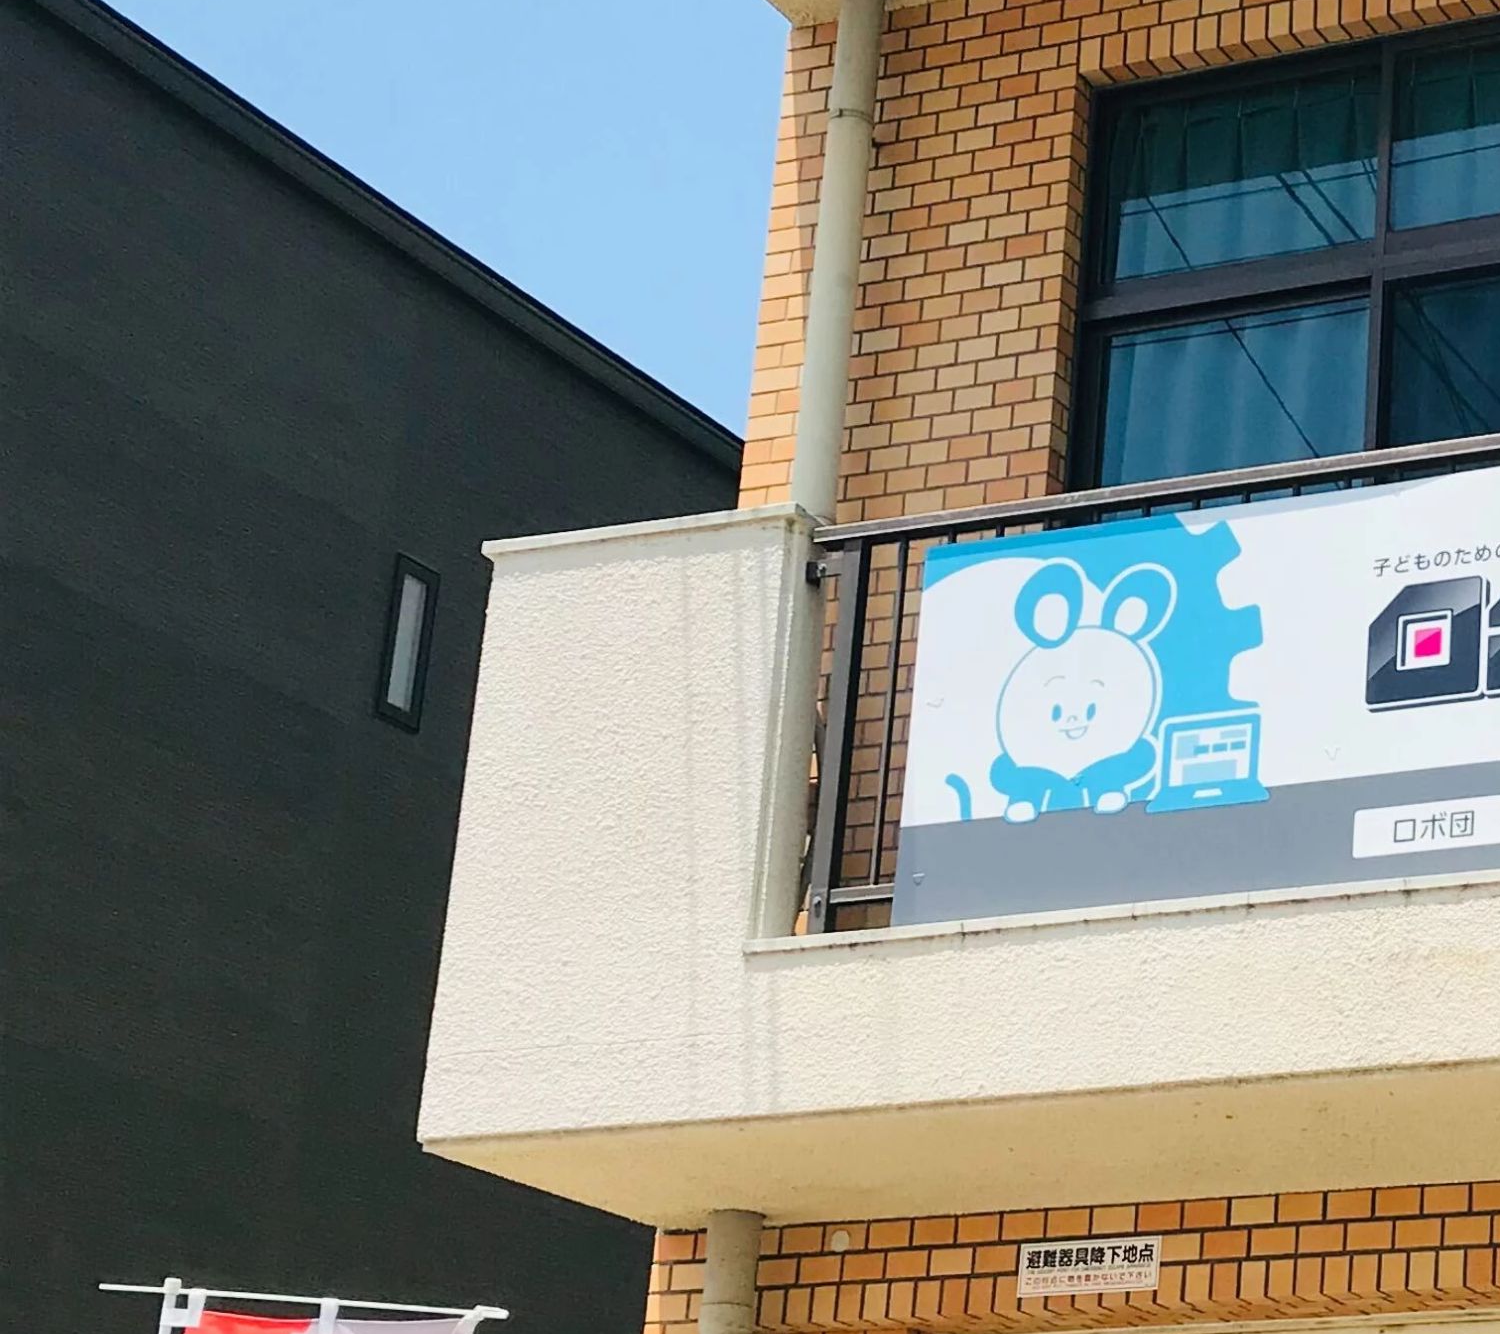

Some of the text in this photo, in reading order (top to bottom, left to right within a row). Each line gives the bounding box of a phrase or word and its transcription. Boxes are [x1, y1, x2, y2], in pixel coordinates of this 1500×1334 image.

[1392, 809, 1476, 844] ロボ団
[1025, 1243, 1156, 1270] 避難器具降下地点
